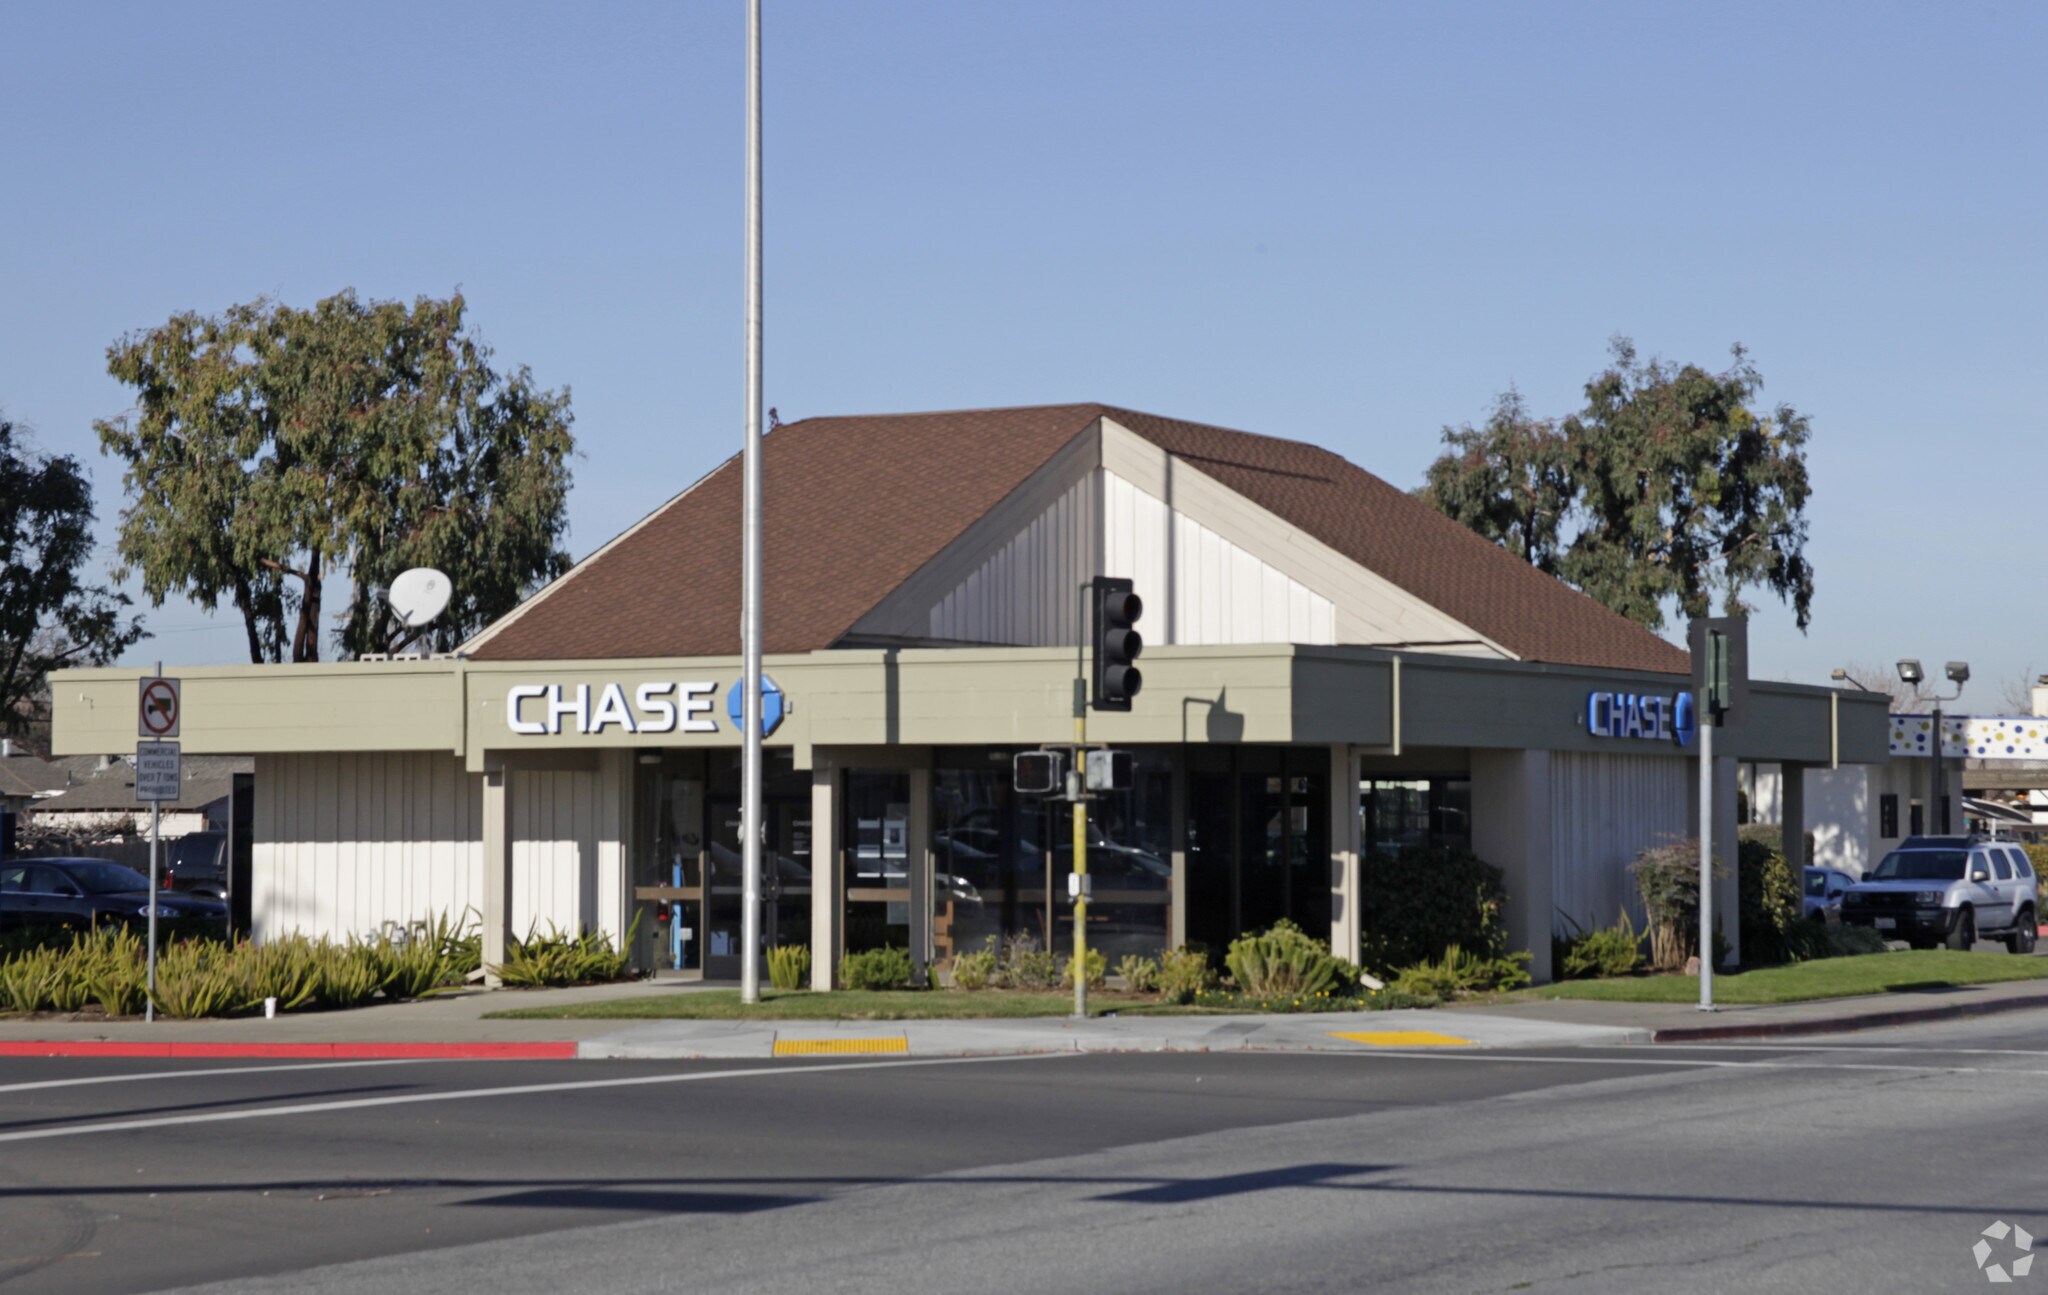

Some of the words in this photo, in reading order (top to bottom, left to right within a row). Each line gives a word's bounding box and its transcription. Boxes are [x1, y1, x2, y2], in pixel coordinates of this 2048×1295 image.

[507, 682, 719, 735] CHASE
[1587, 691, 1673, 740] CHASE
[139, 747, 177, 756] COMMERCIAL
[144, 760, 174, 769] VEHICLES
[139, 773, 155, 782] OVER
[156, 771, 161, 784] 7
[163, 773, 177, 782] TONS
